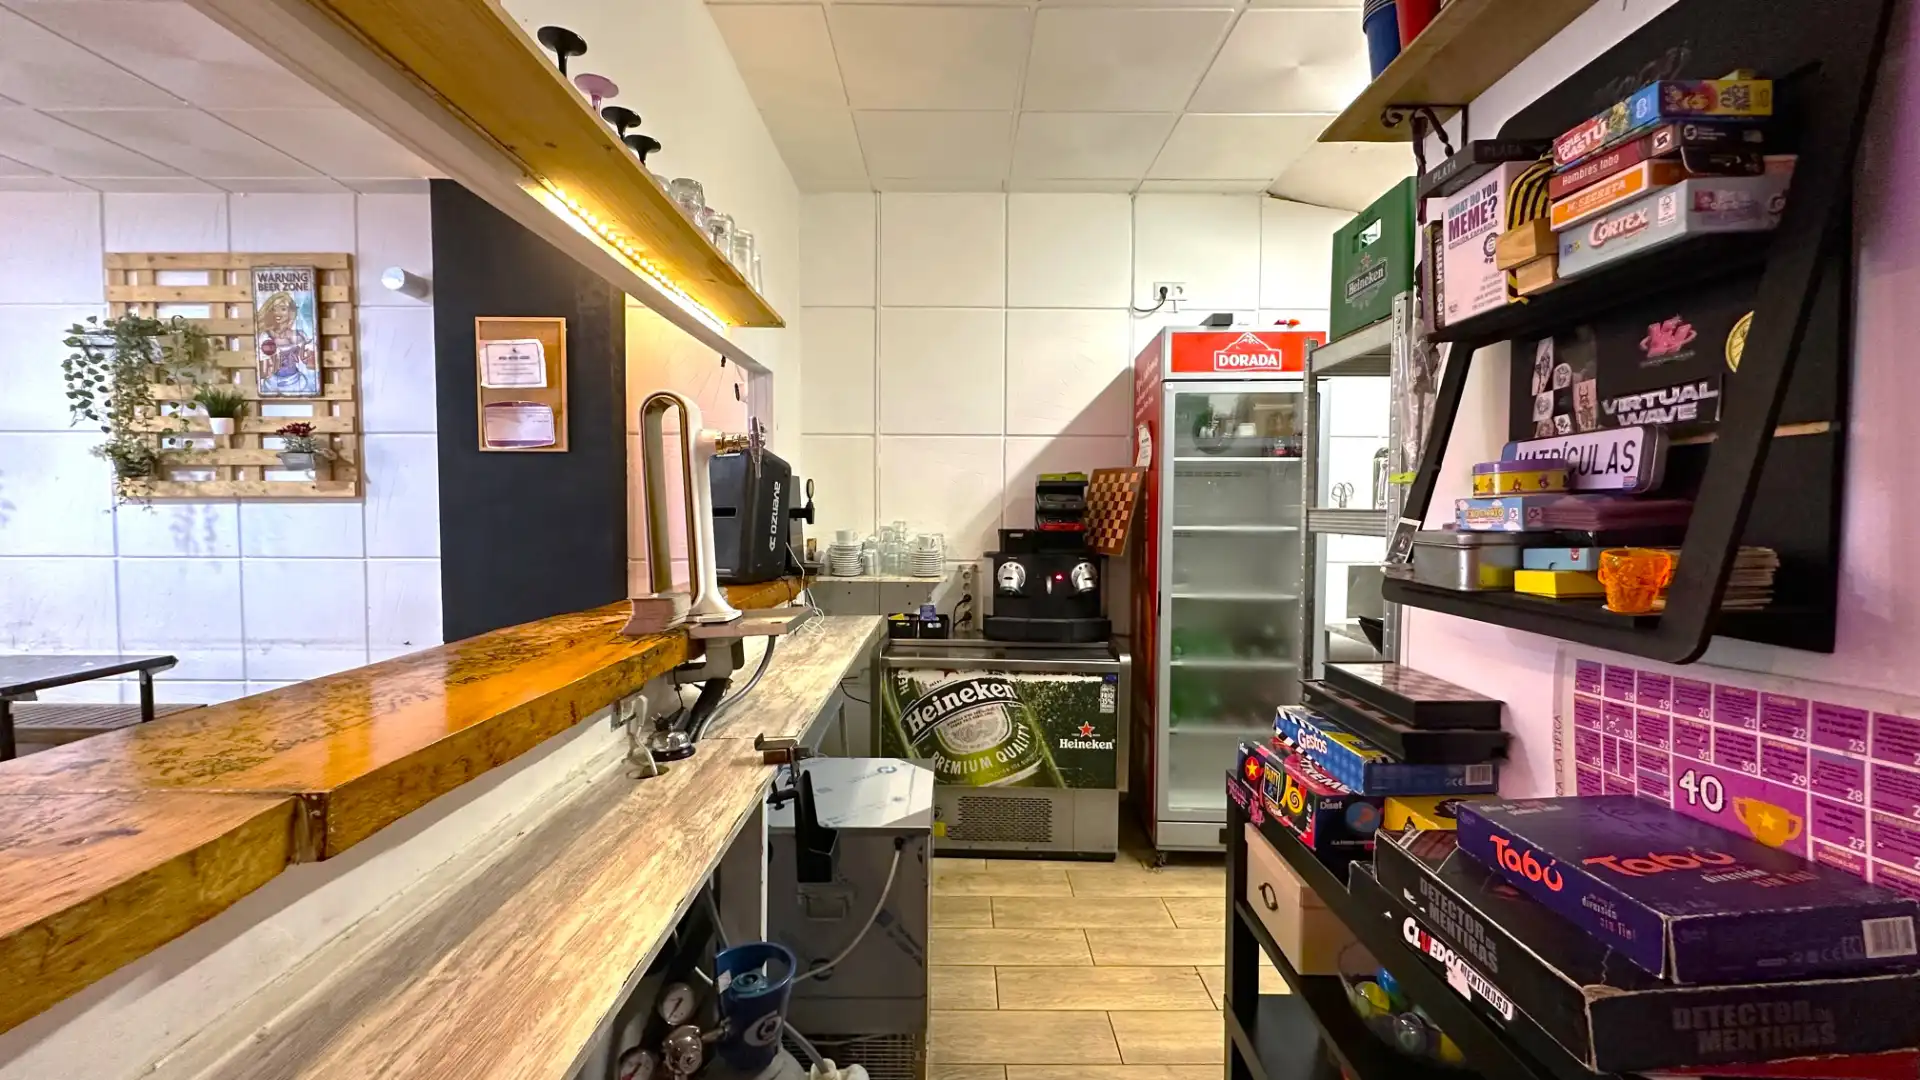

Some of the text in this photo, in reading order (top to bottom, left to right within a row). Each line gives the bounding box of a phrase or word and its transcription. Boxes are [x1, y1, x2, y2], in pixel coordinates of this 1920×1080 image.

[1432, 160, 1457, 185] PLATA
[1562, 154, 1619, 187] Hombres lobo
[1448, 180, 1498, 219] WHAT DO YOU
[1448, 195, 1498, 243] MEME?
[258, 273, 309, 283] WARNING
[258, 283, 309, 292] BEER ZONE
[1347, 268, 1385, 296] Heineken
[1218, 354, 1278, 368] DORADA
[1601, 382, 1719, 415] VIRTUAL
[1616, 401, 1698, 426] WAVE
[1519, 439, 1637, 478] ÍCULAS
[769, 481, 781, 535] avenzo
[906, 676, 1019, 737] Heineken
[1659, 699, 1670, 710] 19
[1698, 707, 1709, 719] 20
[1743, 716, 1757, 729] 21
[1792, 727, 1806, 740] 22
[932, 751, 994, 776] PREMIUM
[995, 721, 1031, 764] QUALITY
[1059, 738, 1114, 750] Heineken
[1698, 748, 1710, 761] 31
[1848, 739, 1866, 753] 23
[1742, 760, 1757, 773] 30
[1791, 773, 1807, 787] 29
[1678, 769, 1724, 814] 40
[1846, 788, 1863, 803] 28
[1848, 836, 1866, 851] 27
[1490, 835, 1563, 892] Tabú
[1582, 847, 1736, 877] Tabú
[1419, 877, 1485, 943] DETECTOR
[1429, 903, 1498, 974] MENTIRAS
[1403, 916, 1510, 1016] CLUEDO MENTIROSO
[1673, 1001, 1811, 1030] DETECTOR
[1697, 1023, 1837, 1054] MENTIRAS
